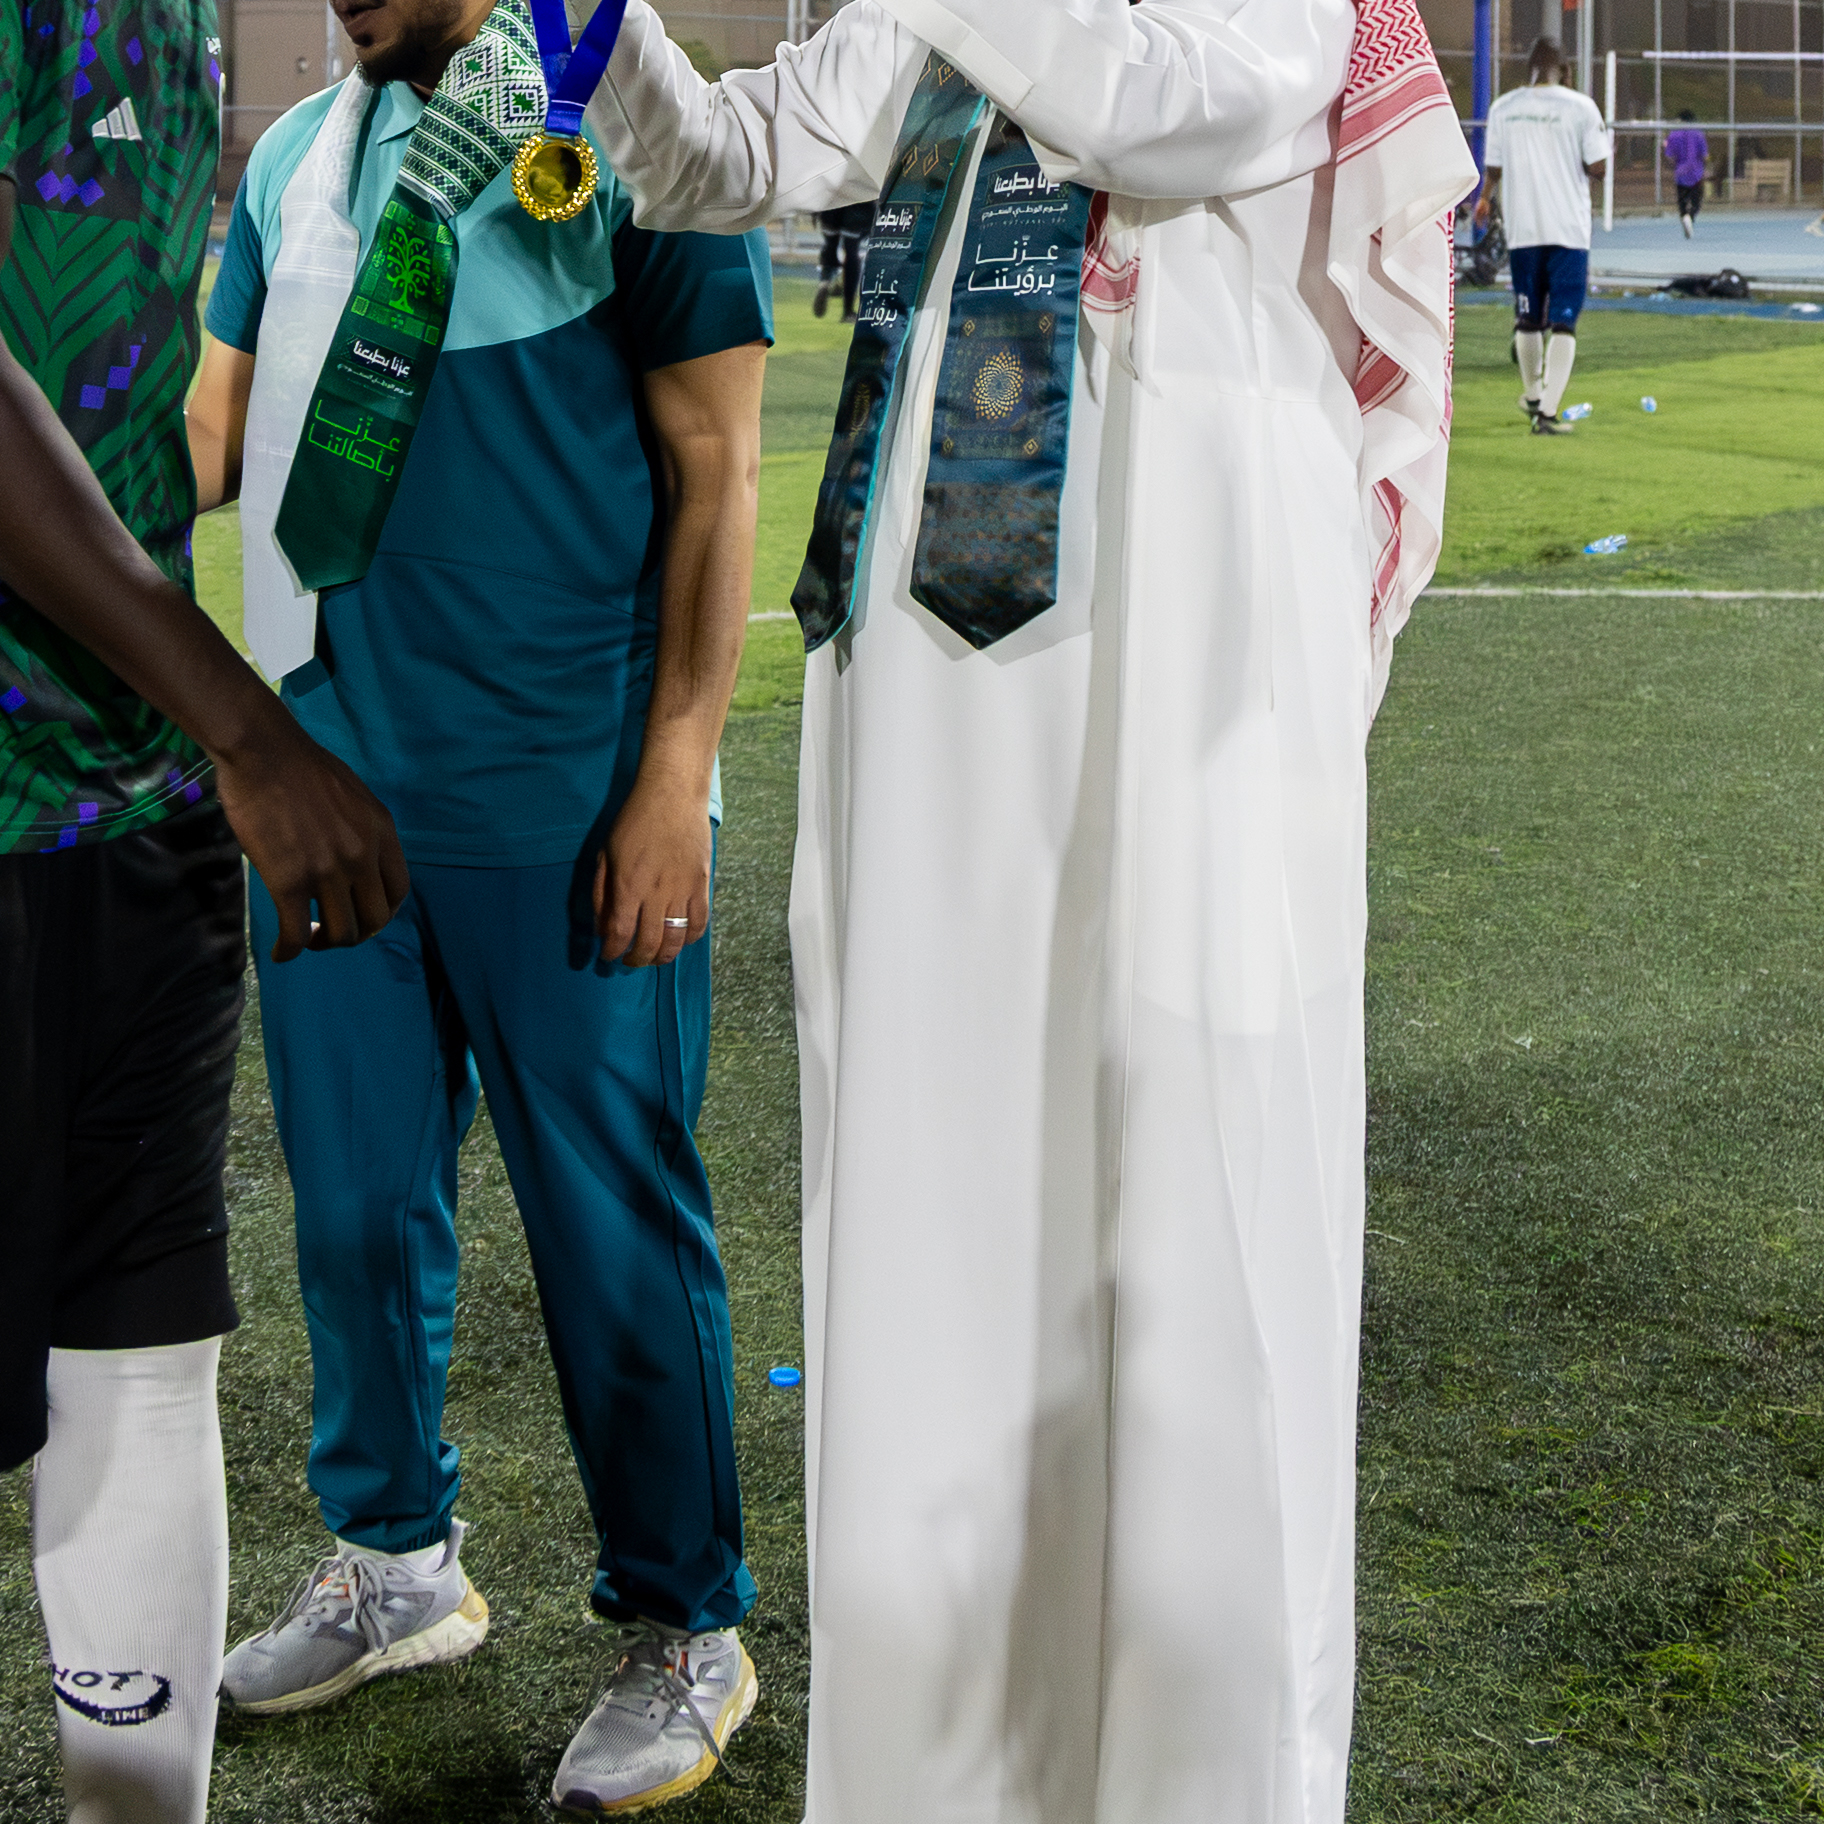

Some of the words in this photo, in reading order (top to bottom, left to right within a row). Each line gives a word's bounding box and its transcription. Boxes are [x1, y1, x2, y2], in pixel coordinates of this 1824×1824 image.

[993, 171, 1035, 198] بطبعنا
[968, 265, 1056, 297] برؤيتنا
[308, 422, 395, 483] بأصالتنا
